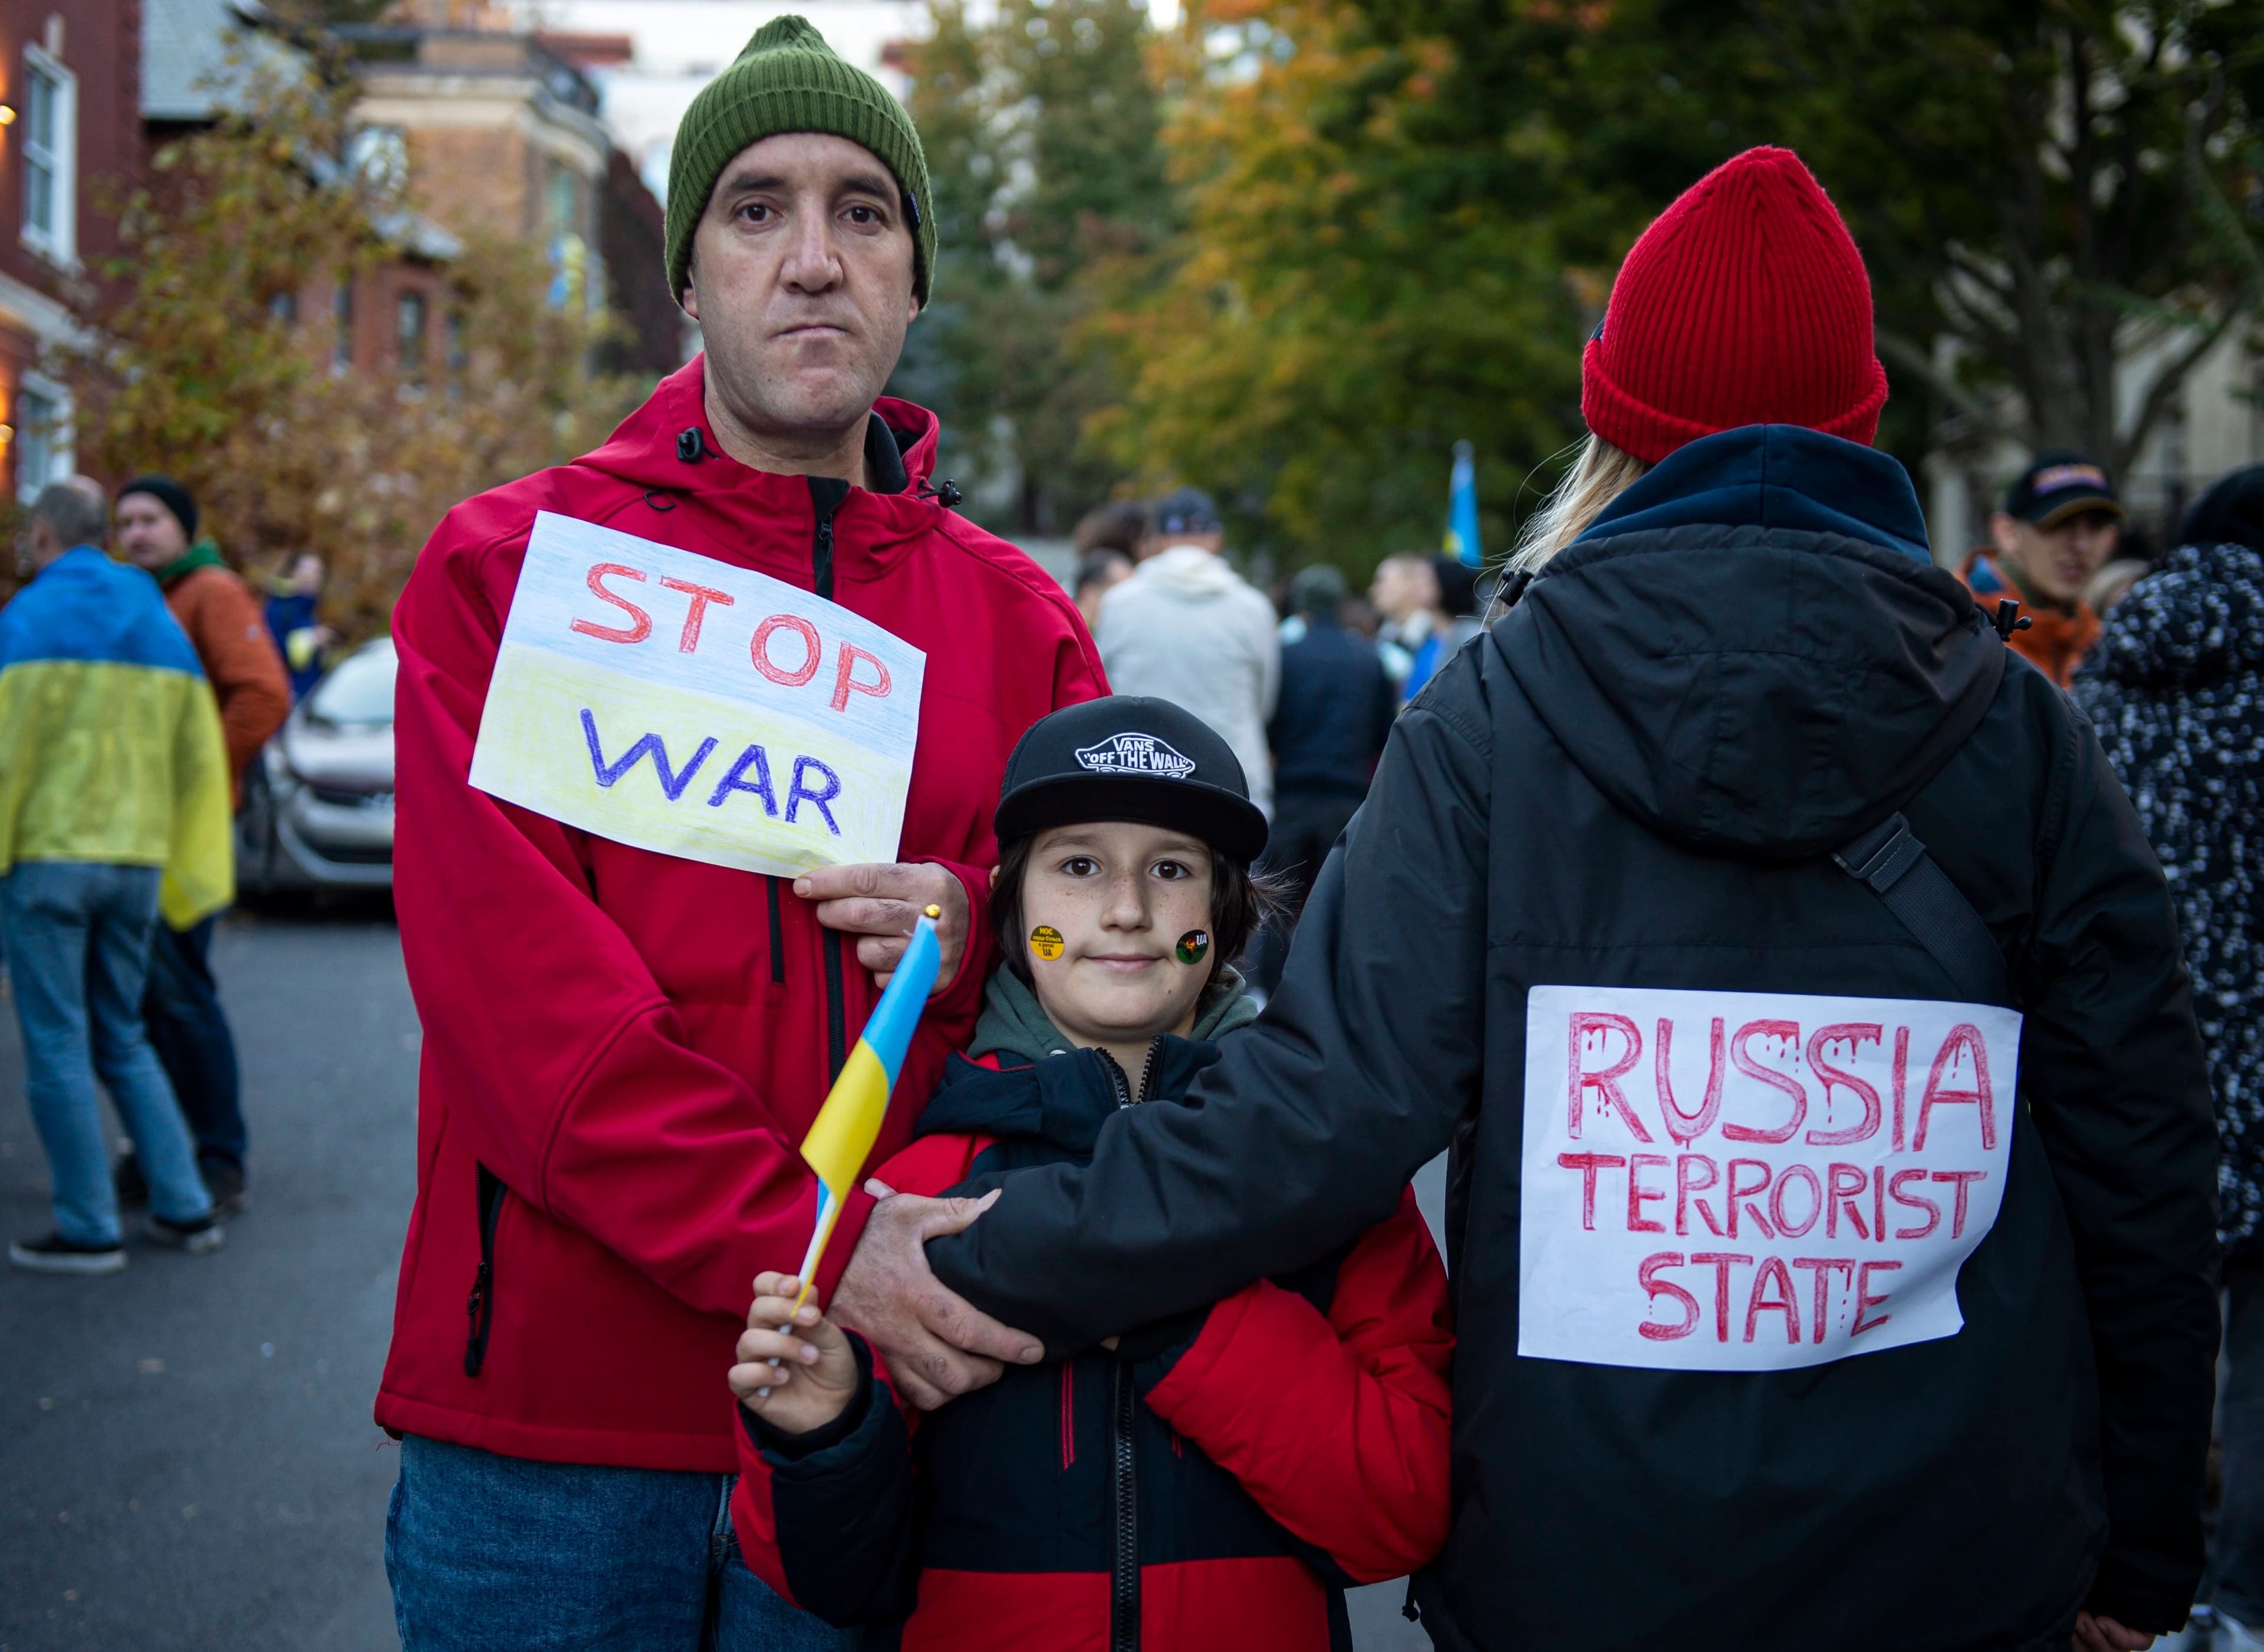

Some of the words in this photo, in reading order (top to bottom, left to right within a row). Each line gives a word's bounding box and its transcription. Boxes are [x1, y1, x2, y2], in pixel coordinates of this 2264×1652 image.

[569, 562, 892, 712] STOP
[580, 708, 841, 836] WAR
[1113, 738, 1154, 752] VANS
[1117, 751, 1149, 769] THE
[1196, 933, 1207, 945] UA
[1568, 1012, 1996, 1152] RUSSIA
[1557, 1150, 1987, 1243] TERRORIST
[1638, 1251, 1903, 1344] STATE
